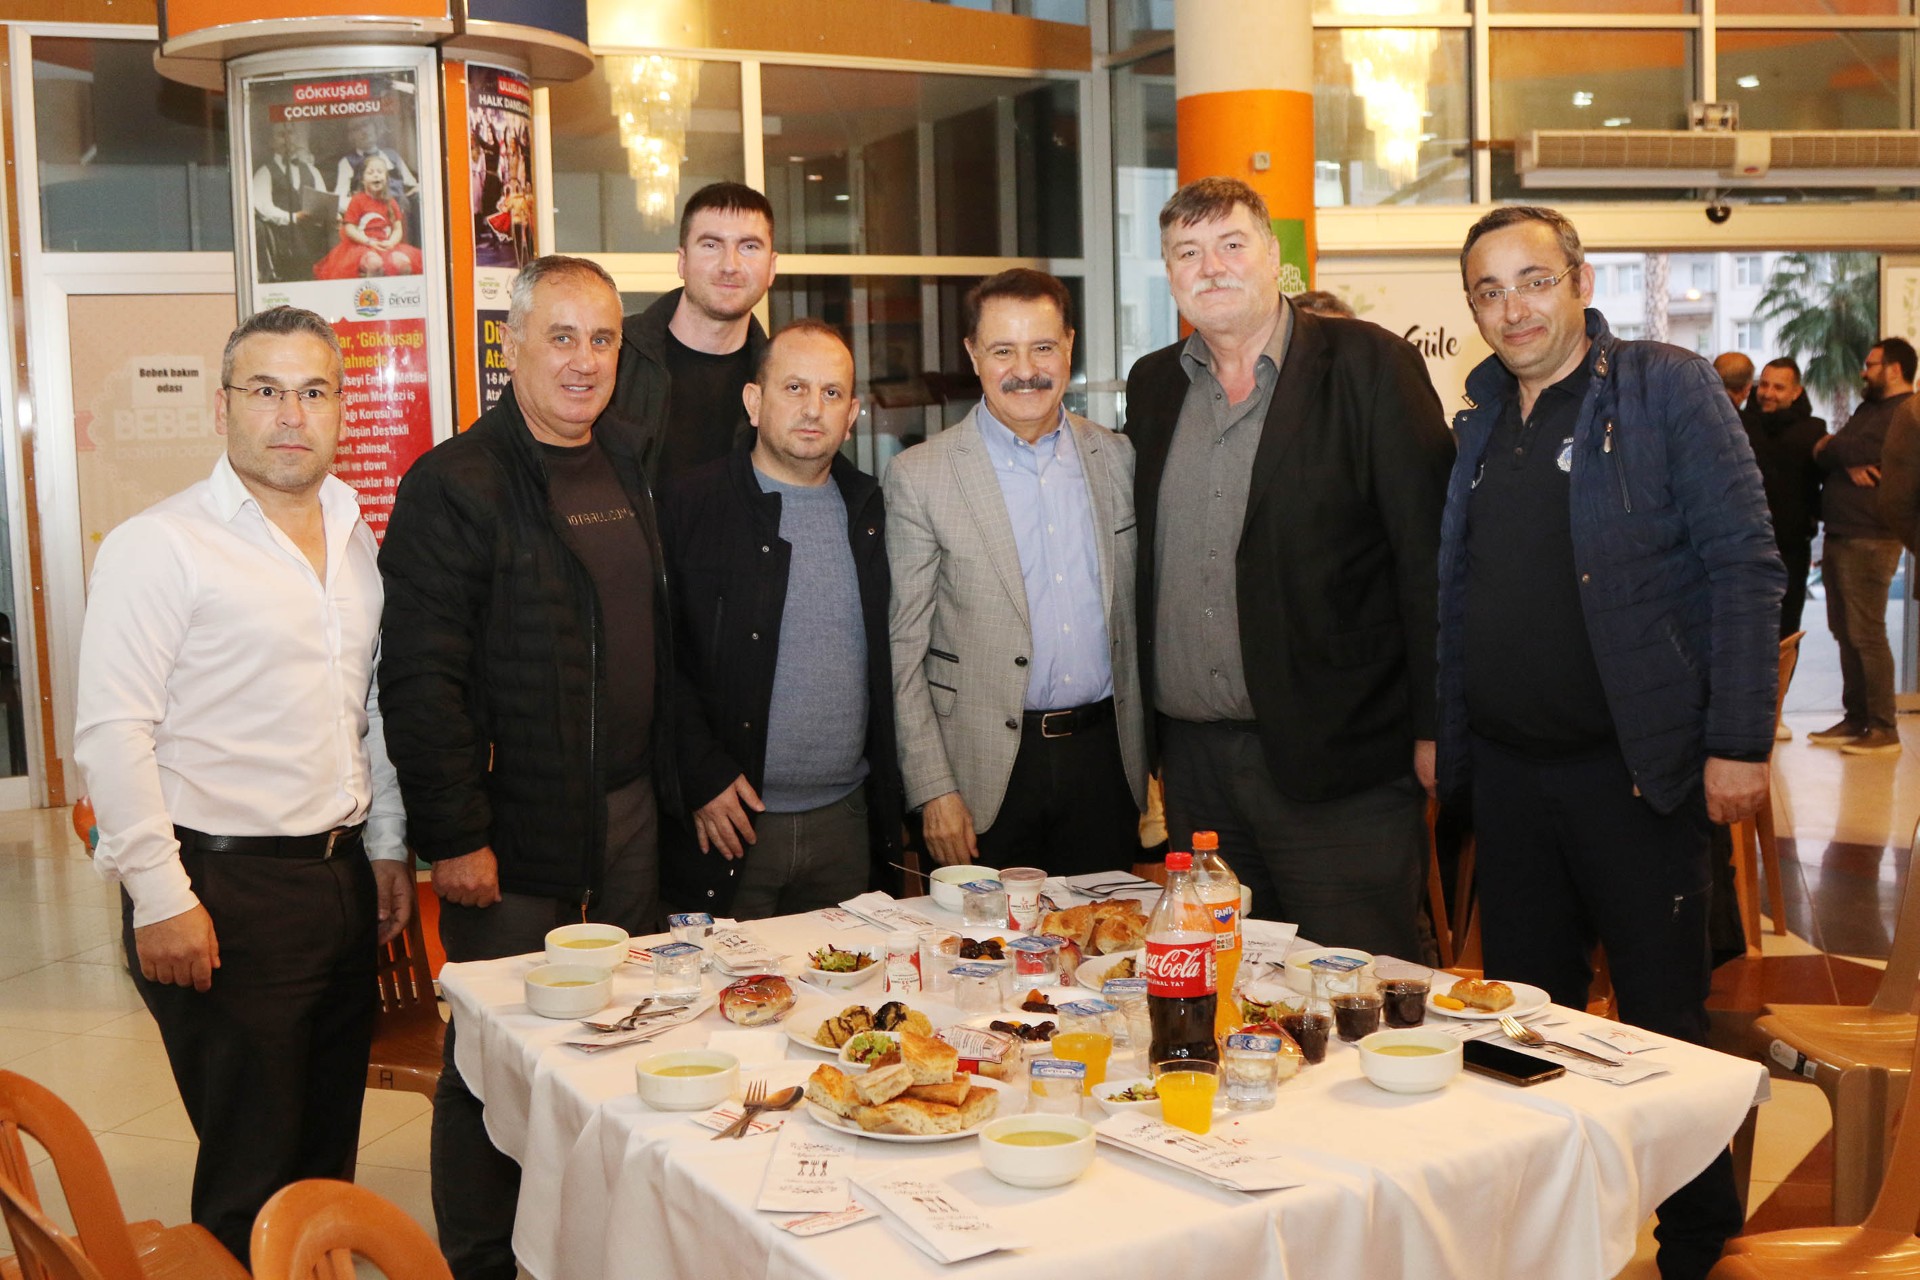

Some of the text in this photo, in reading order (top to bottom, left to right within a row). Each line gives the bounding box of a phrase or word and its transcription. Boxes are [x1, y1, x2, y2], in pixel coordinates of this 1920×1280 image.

[295, 82, 368, 100] GÖKKUŞAĞI
[478, 94, 504, 107] HALK
[284, 101, 381, 121] ÇOCUK KOROSU
[139, 368, 199, 378] Bebek bakım
[157, 384, 183, 393] odası
